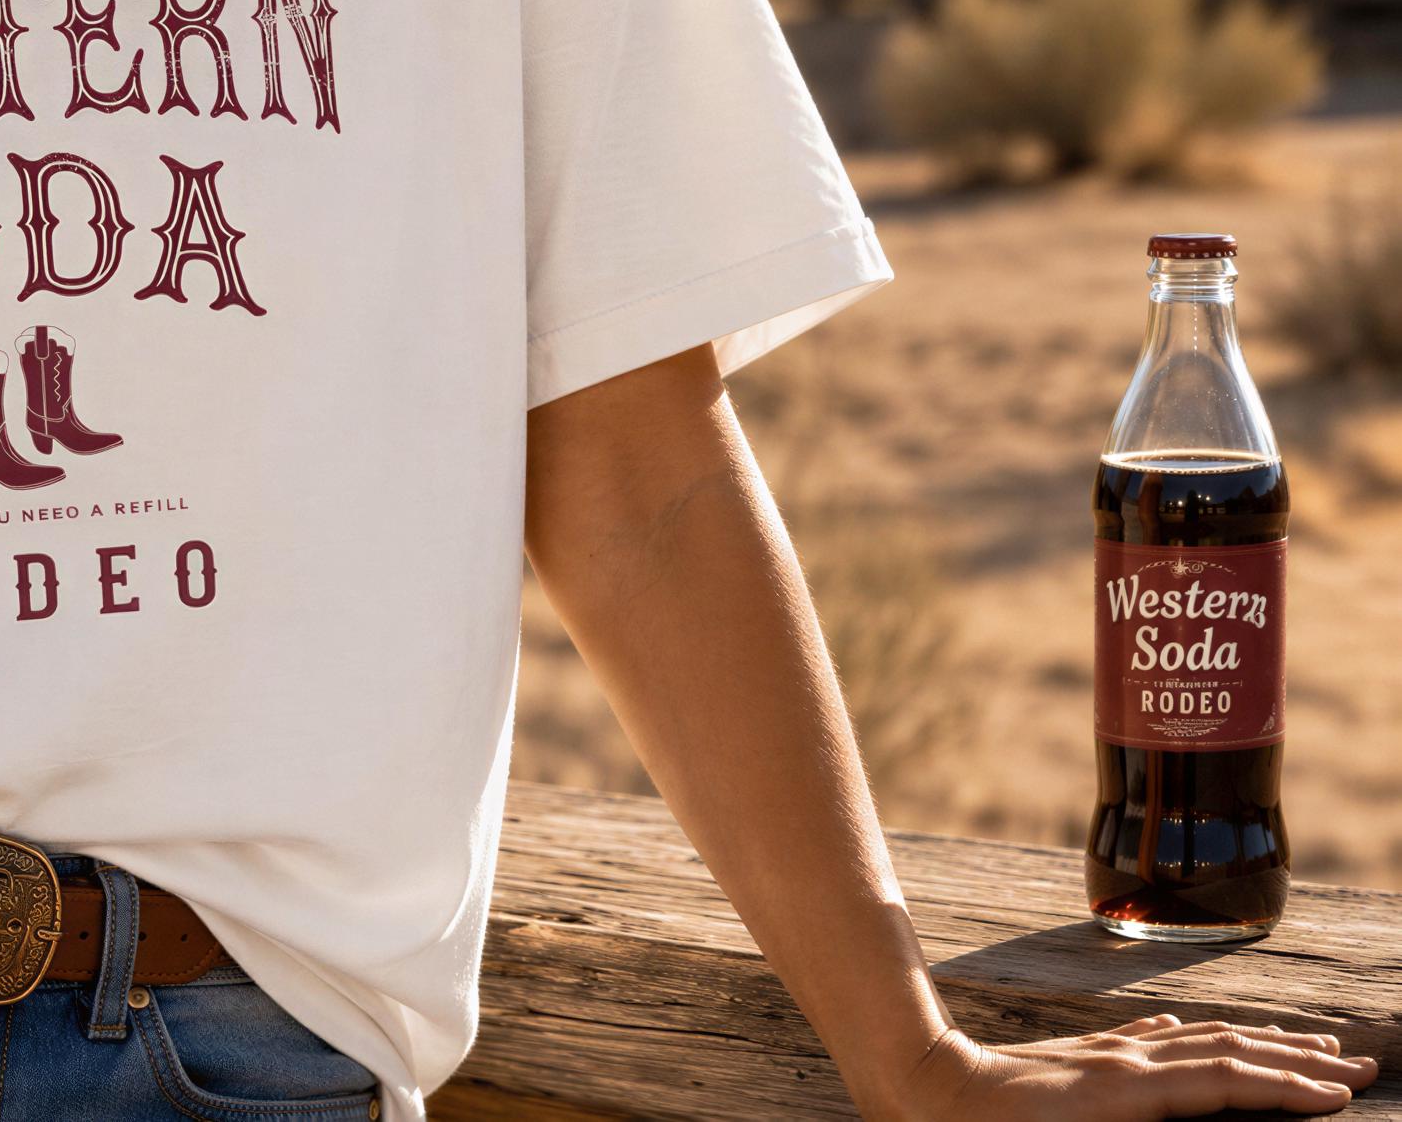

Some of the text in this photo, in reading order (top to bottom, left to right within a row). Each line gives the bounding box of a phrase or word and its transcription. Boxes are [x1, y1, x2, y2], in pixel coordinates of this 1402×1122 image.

[90, 504, 104, 517] A
[115, 497, 189, 515] REFILL
[1131, 625, 1241, 671] Soda
[1141, 690, 1231, 714] RODEO
